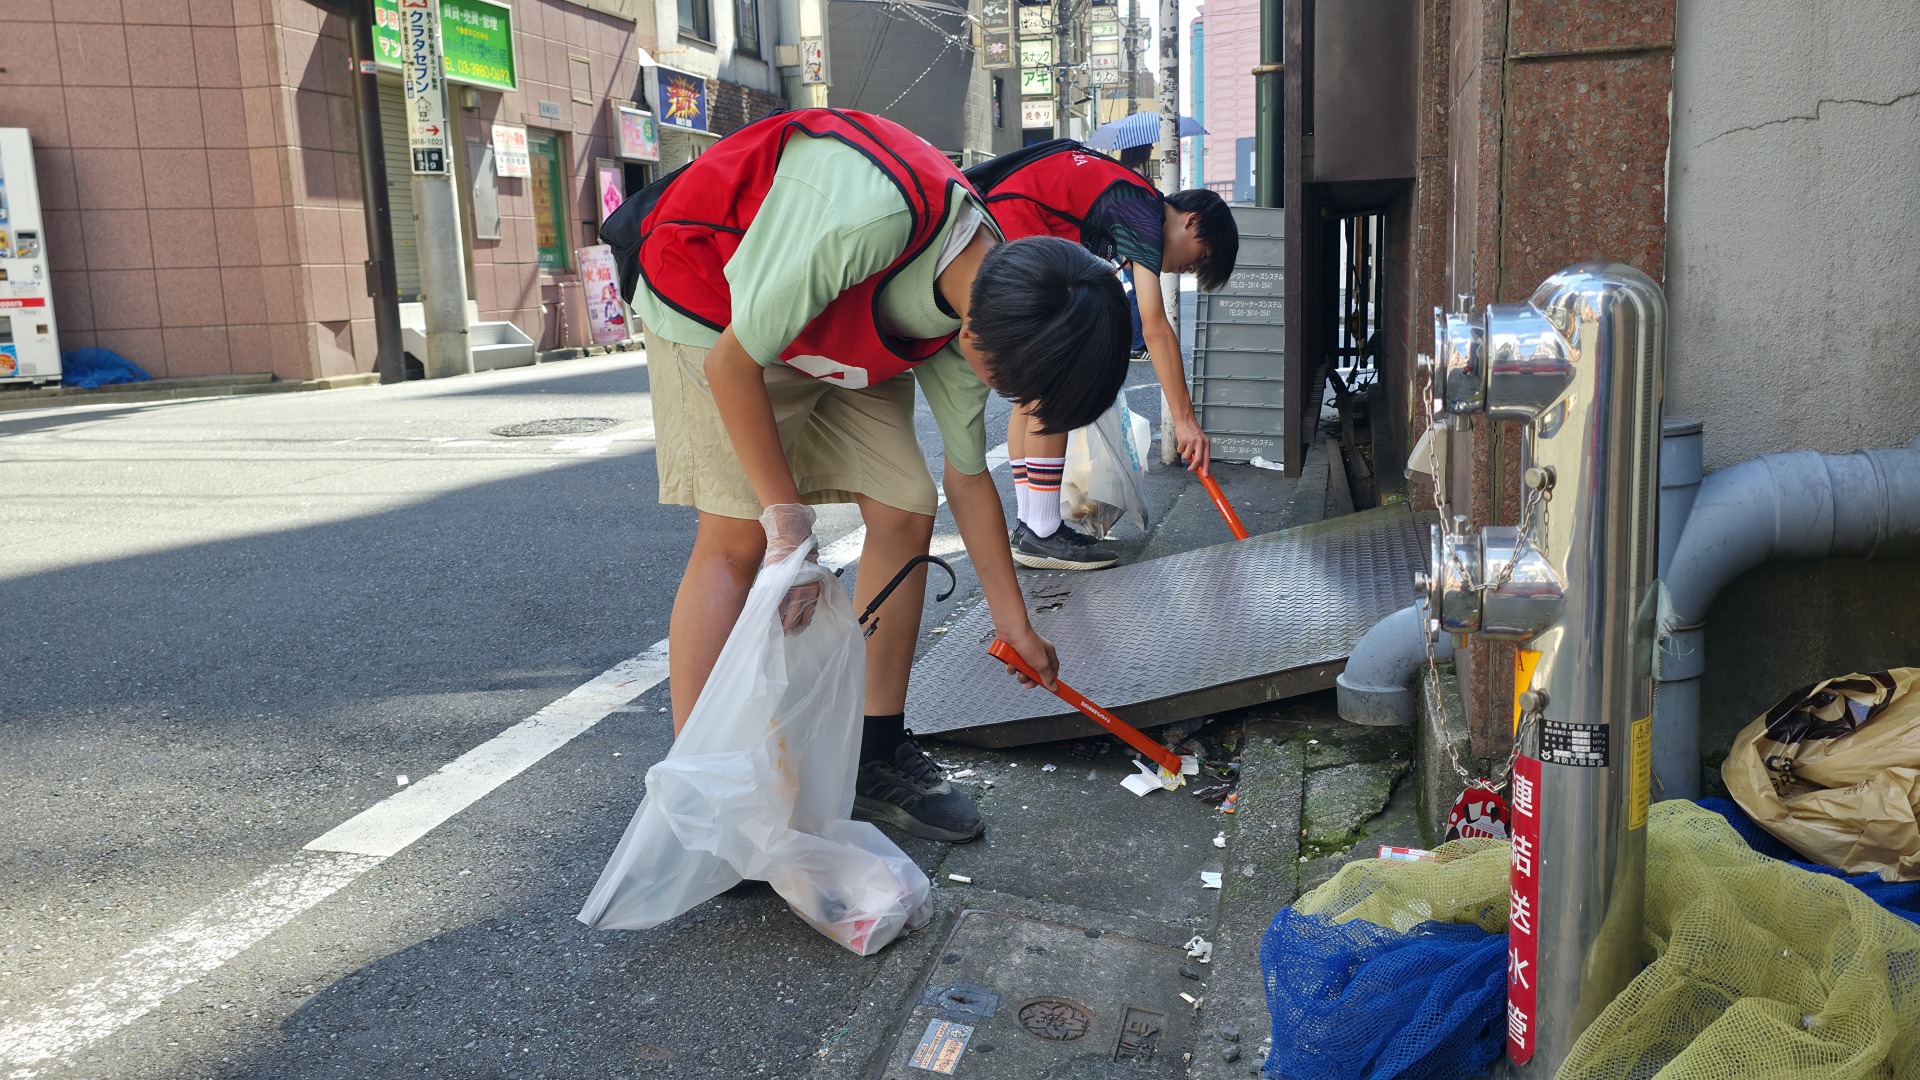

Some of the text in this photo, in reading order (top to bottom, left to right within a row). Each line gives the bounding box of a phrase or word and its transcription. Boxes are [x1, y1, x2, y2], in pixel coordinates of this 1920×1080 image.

[410, 11, 429, 93] クラタセブン
[1023, 50, 1049, 62] スナック
[1024, 71, 1049, 86] アキ
[1026, 111, 1050, 121] 花祭り
[1507, 773, 1533, 1050] 連結送水管
